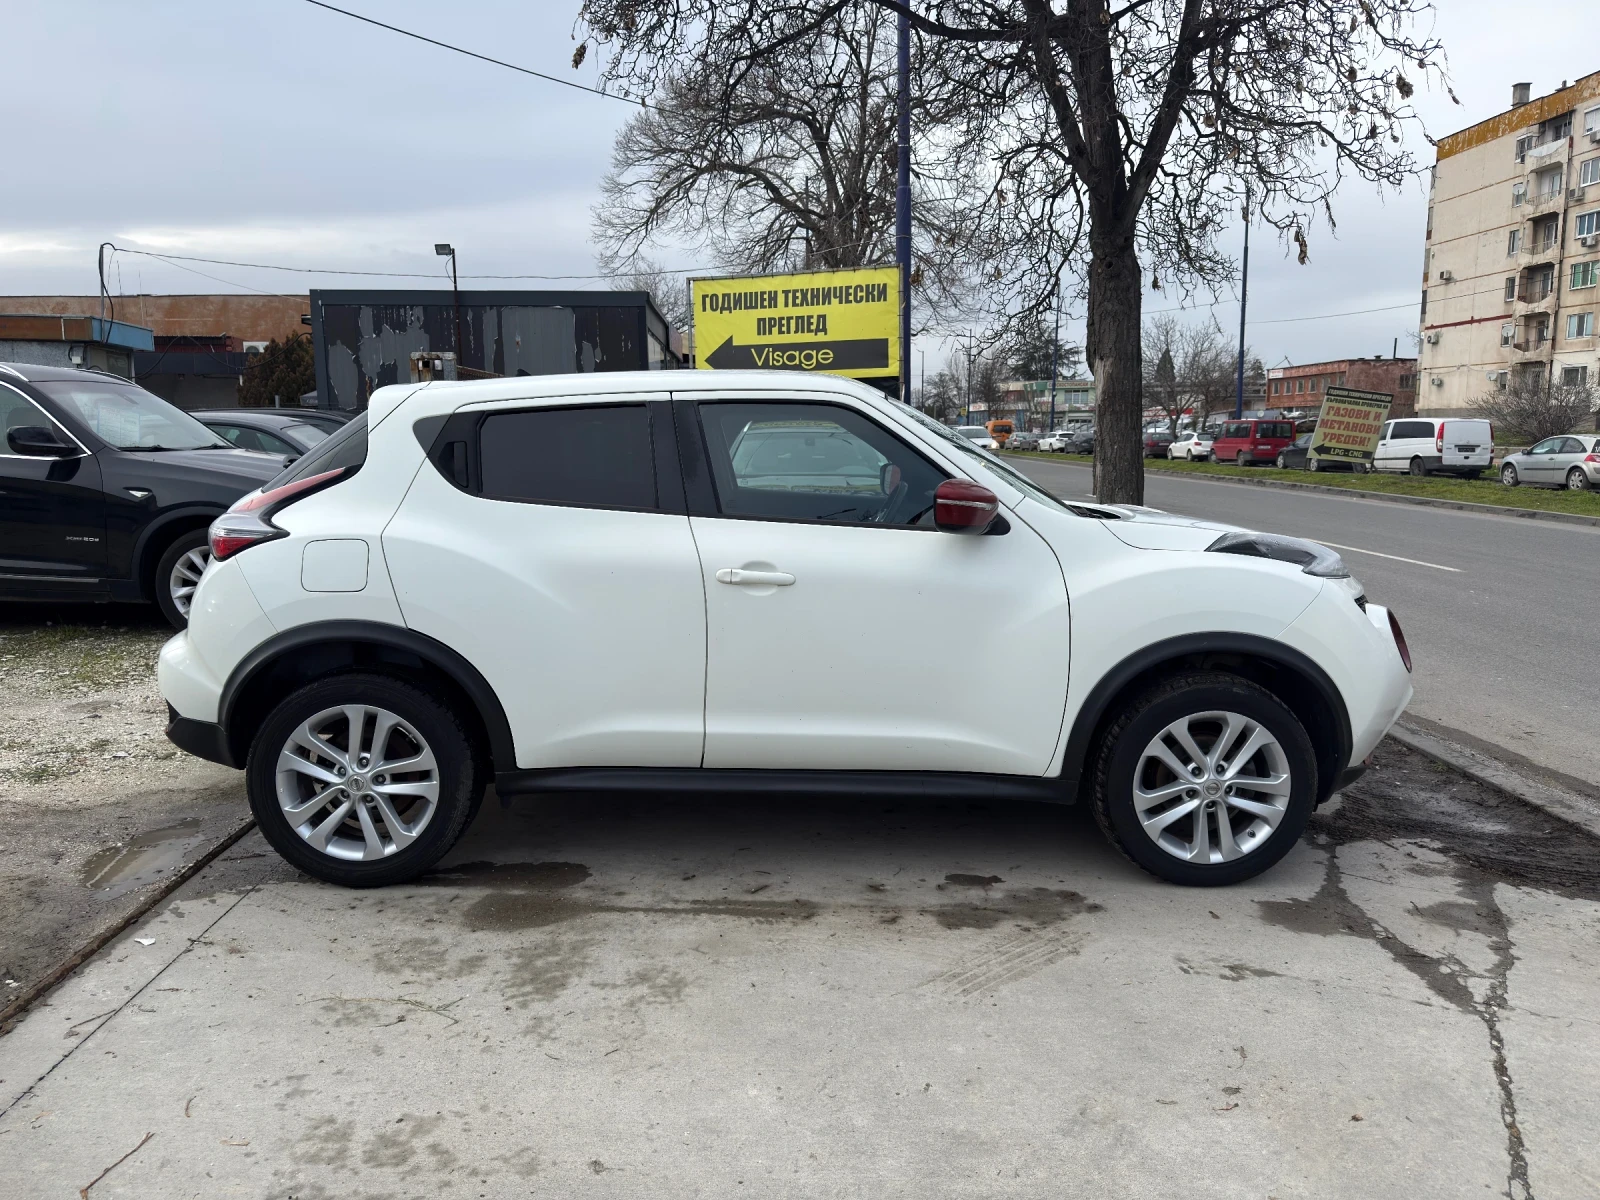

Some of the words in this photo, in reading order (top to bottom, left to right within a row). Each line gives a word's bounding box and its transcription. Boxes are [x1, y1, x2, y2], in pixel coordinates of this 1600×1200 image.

[702, 290, 778, 314] ГОДИШЕН
[782, 283, 888, 308] ТЕХНИЧЕСКИ
[756, 314, 828, 336] ПРЕГЛЕД
[751, 347, 834, 369] Visage
[1326, 406, 1372, 420] ГАЗОВИ
[1373, 411, 1382, 421] И
[1319, 418, 1381, 436] МЕТАНОВИ
[1322, 432, 1370, 447] УРЕДБИ!
